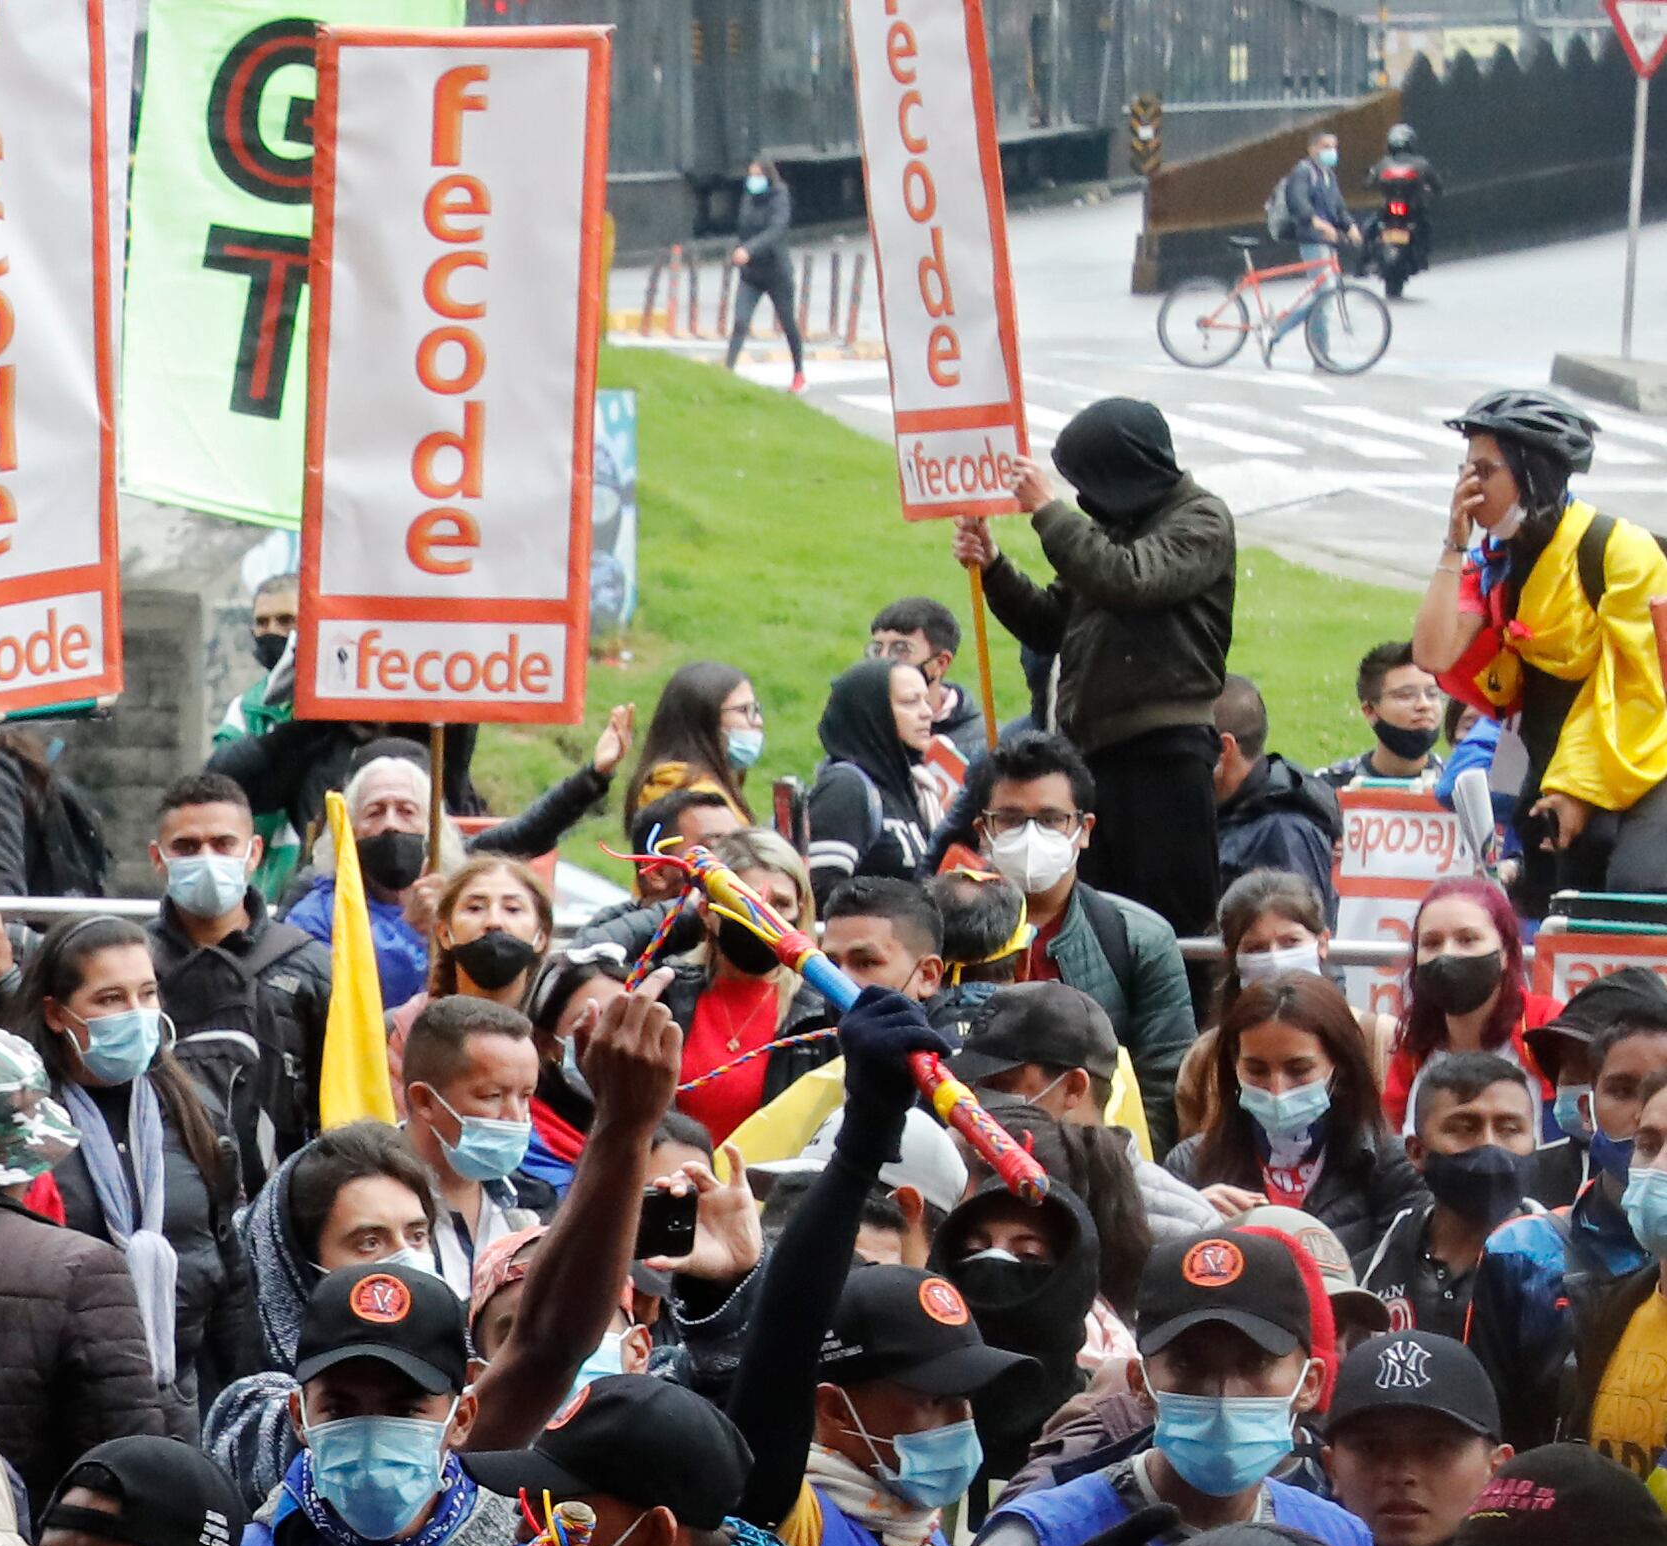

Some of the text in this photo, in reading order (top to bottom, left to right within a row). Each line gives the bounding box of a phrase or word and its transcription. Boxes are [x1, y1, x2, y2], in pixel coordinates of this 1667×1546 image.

[405, 63, 493, 576] fecode
[913, 435, 1012, 500] fecode
[354, 627, 554, 695] fecode
[1347, 815, 1456, 874] fecode
